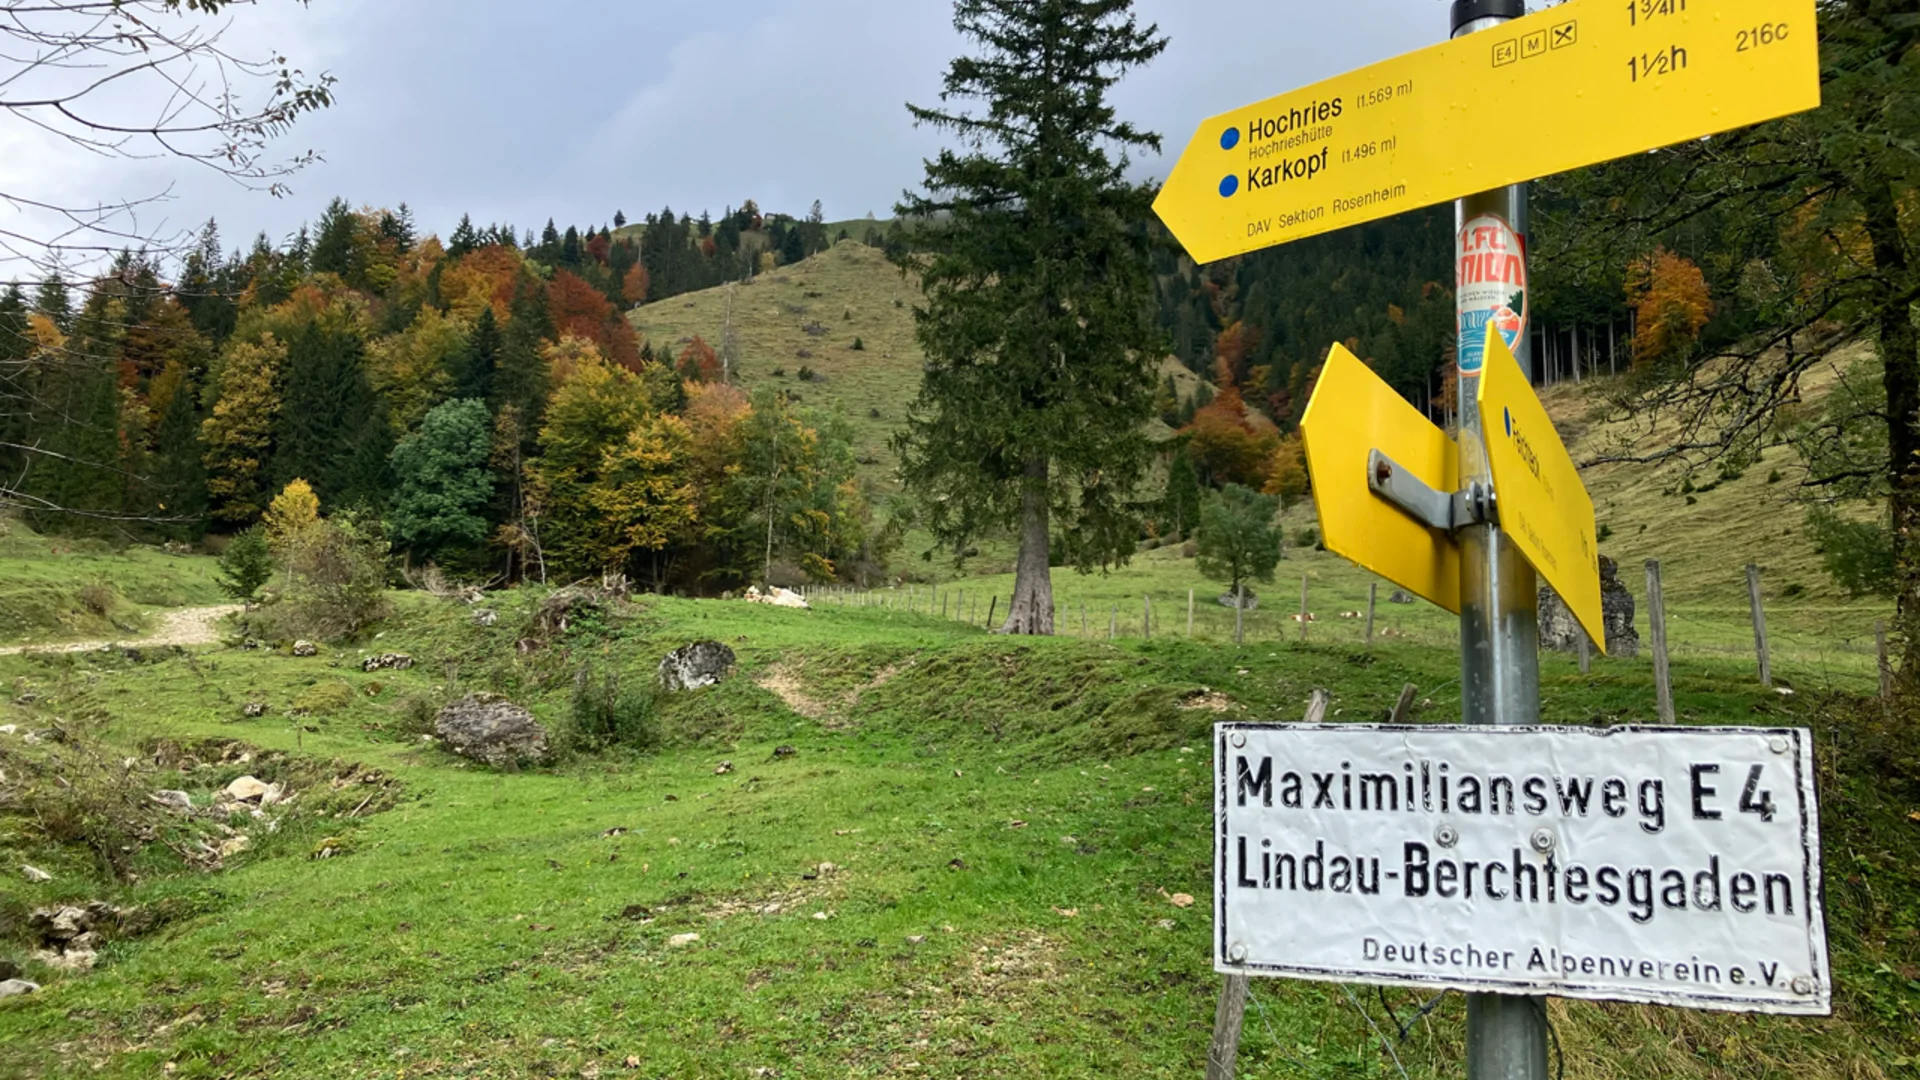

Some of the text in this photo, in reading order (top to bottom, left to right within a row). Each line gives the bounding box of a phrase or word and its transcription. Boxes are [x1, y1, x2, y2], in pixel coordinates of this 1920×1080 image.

[1496, 38, 1540, 62] E4 M
[1736, 22, 1790, 52] 216c
[1247, 80, 1413, 143] Hochries (1.569 m)
[1247, 136, 1397, 191] Karkopf (1.496 m)
[1248, 125, 1333, 161] Hochrieshütte
[1246, 183, 1406, 238] DAV Sektion Rosenheim
[1456, 252, 1523, 288] NION
[1236, 756, 1777, 833] Maximiliansweg E 4
[1237, 835, 1795, 924] Lindau-Berchtesgaden
[1362, 938, 1515, 970] Deutscher
[1527, 946, 1726, 982] Alpenverein
